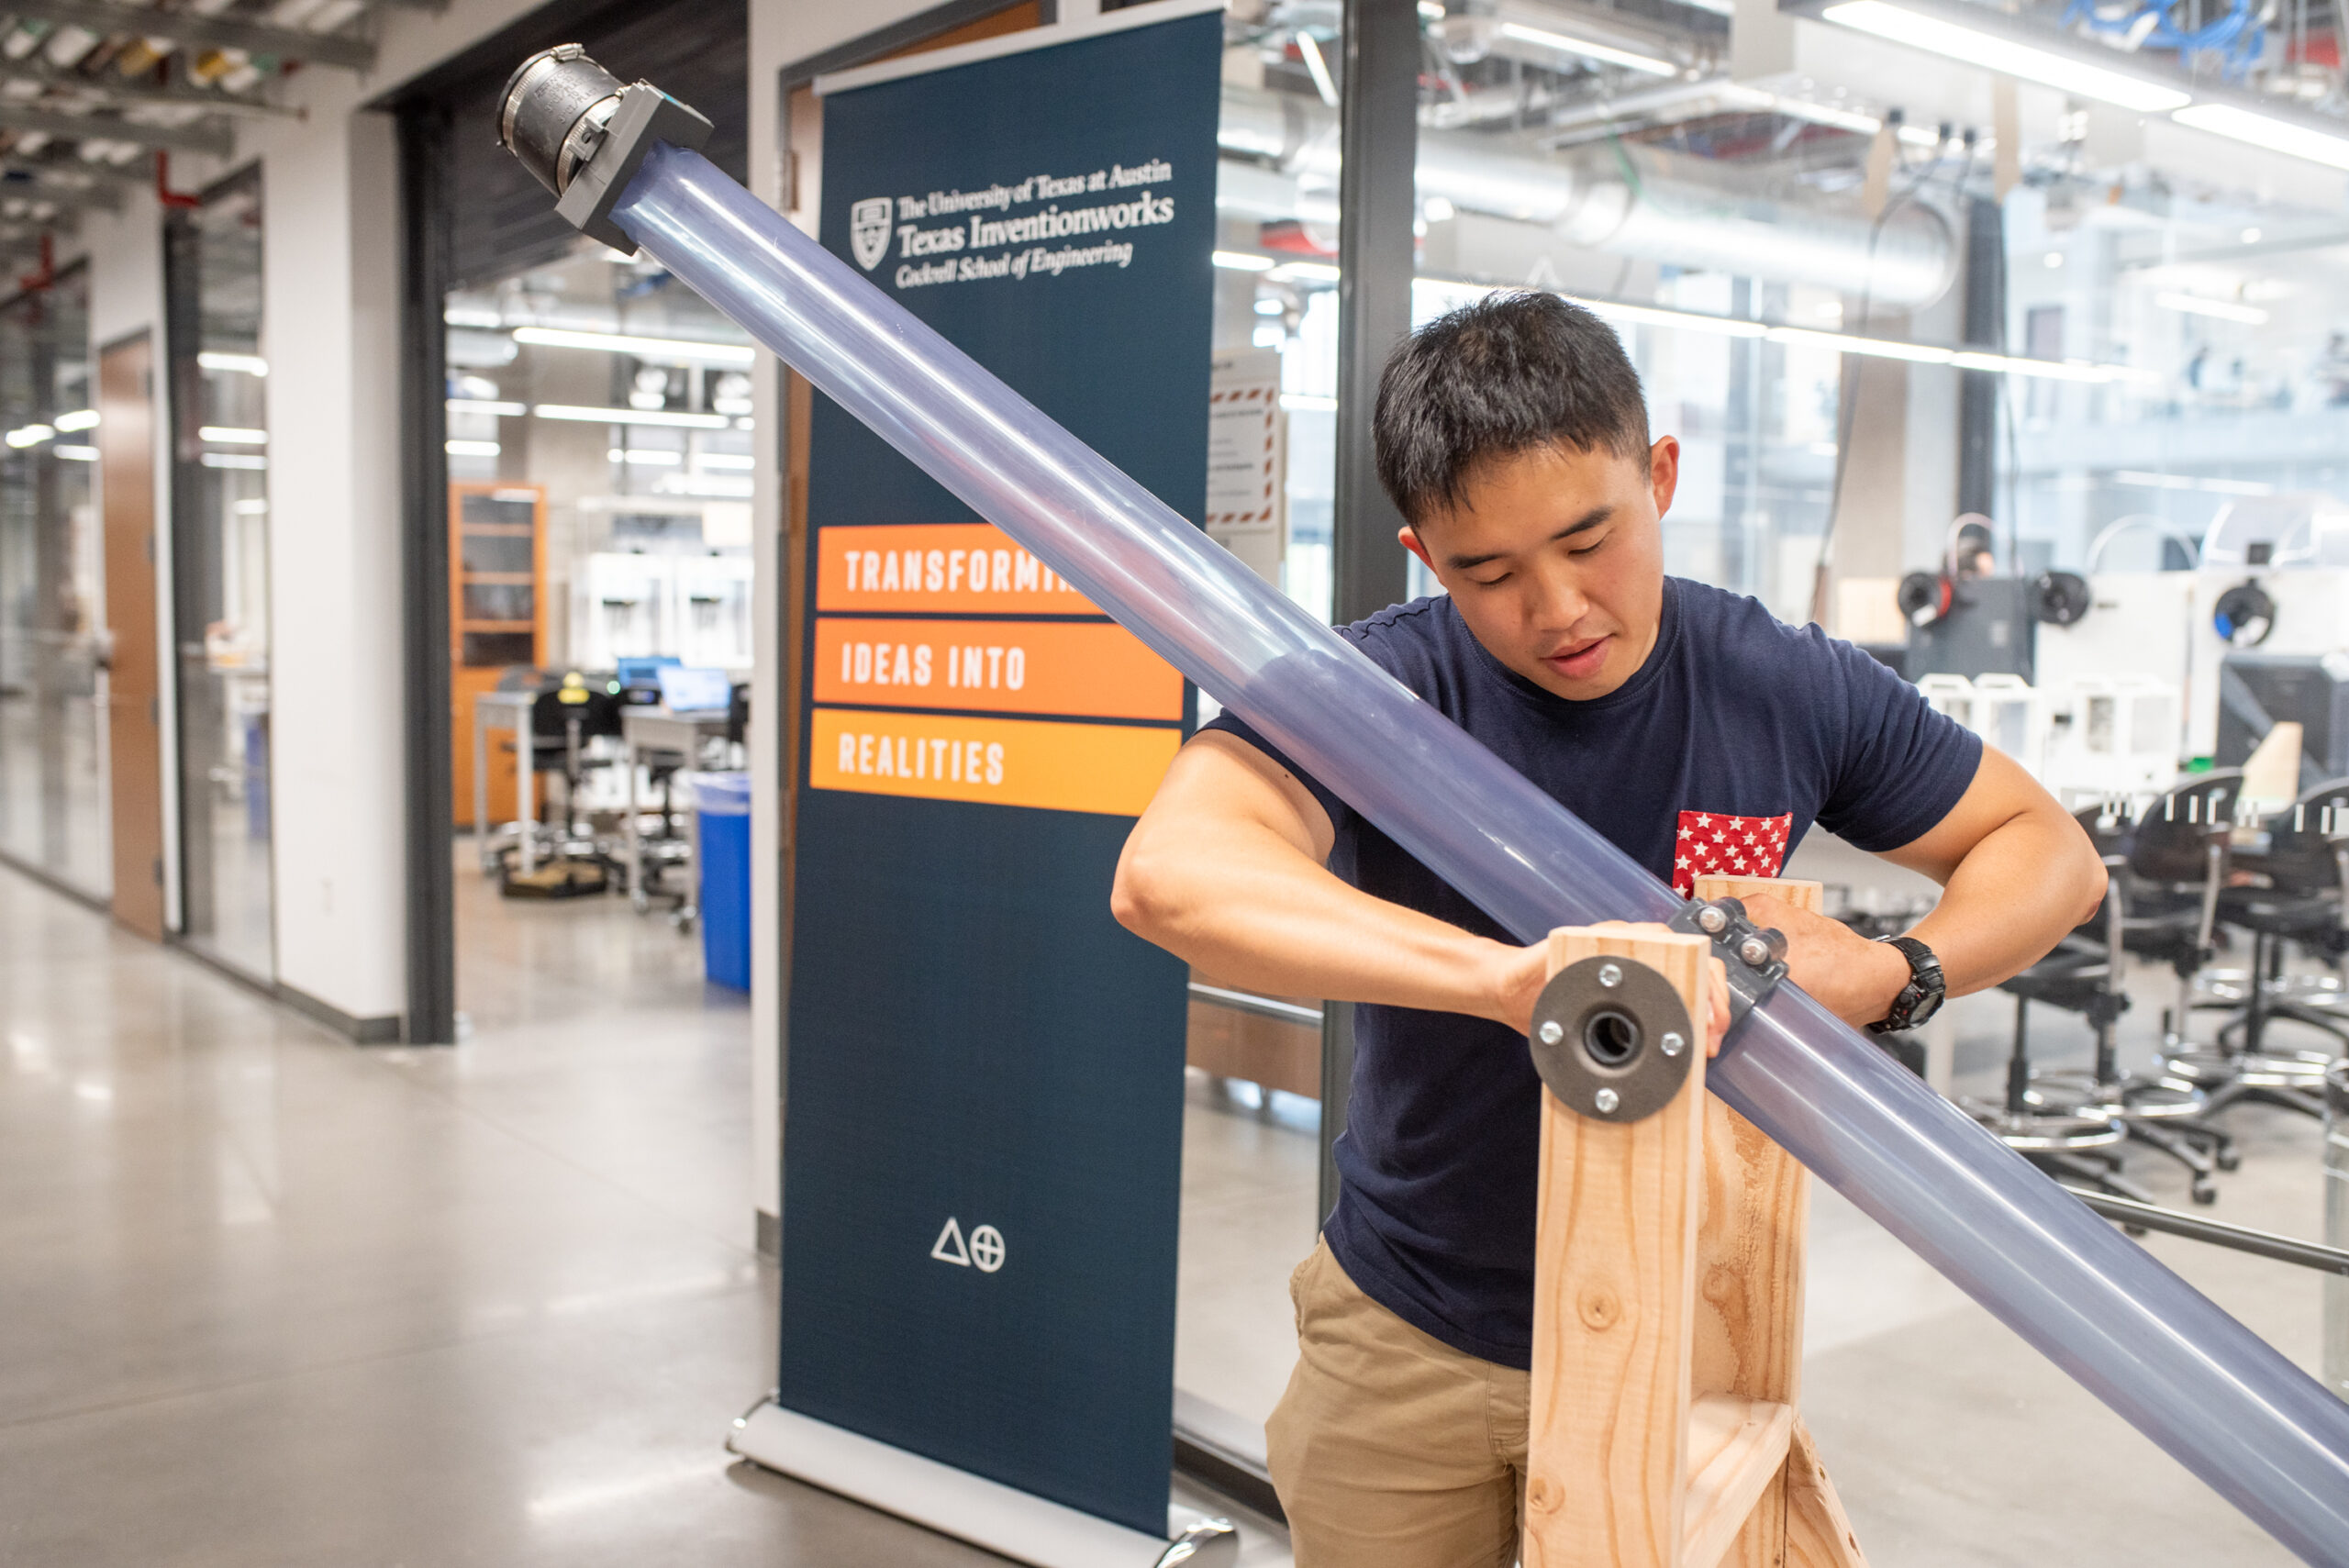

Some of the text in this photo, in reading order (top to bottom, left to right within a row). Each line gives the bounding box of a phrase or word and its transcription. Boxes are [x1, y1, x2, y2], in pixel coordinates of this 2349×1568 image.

[896, 158, 1173, 221] The University of Texas at Austin
[896, 190, 1174, 258] Texas Inventionworks
[896, 239, 1133, 289] Cockrell School of Engineering
[845, 548, 1077, 593] TRANSFORMI
[841, 642, 1026, 690] IDEAS INTO
[839, 732, 1004, 785] REALITIES
